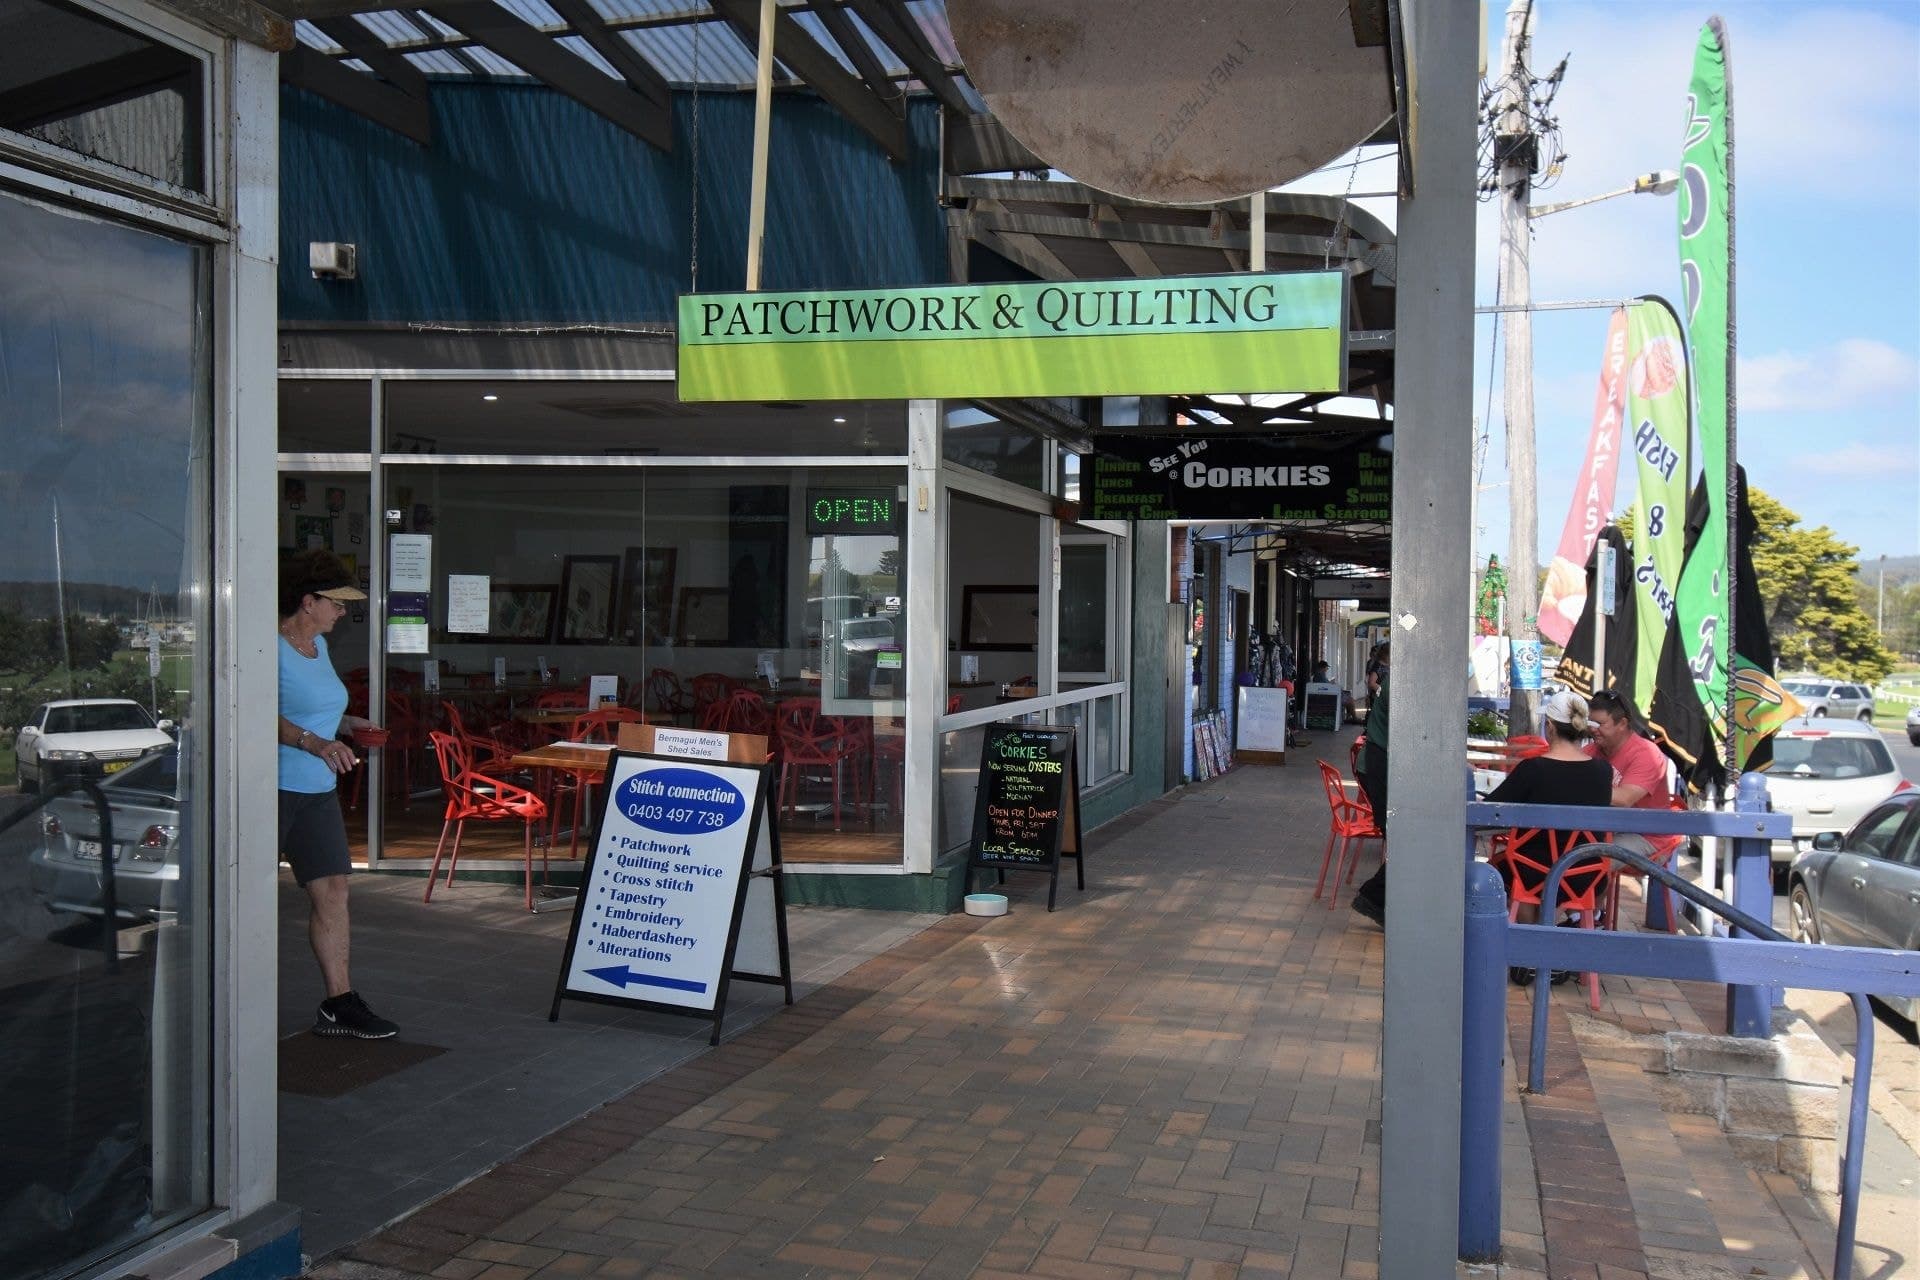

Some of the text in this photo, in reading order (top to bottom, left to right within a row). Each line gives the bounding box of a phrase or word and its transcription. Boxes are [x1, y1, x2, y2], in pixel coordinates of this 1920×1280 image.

[701, 285, 1278, 336] PATCHWORK & QUILTING
[1095, 457, 1141, 472] DINNER
[1148, 439, 1208, 473] SEE YOU
[1095, 473, 1133, 488] LUNCH
[1168, 461, 1331, 488] @ CORKIES
[1095, 489, 1164, 505] BREAKFAST
[1346, 488, 1389, 504] SPIRITS
[815, 499, 889, 522] OPEN
[1095, 505, 1121, 520] FISH
[1140, 505, 1178, 520] CHIPS
[1273, 503, 1388, 519] LOCAL SEAFOOD
[658, 733, 723, 746] Bermagui Men's
[667, 745, 713, 757] Shed Sales
[1000, 744, 1048, 760] CORKIES
[1028, 761, 1062, 774] OYSTERS
[629, 778, 736, 804] Stitch connection
[628, 803, 724, 827] 0403 497 738
[988, 805, 1009, 817] OPEN
[1028, 806, 1059, 820] DINNER
[620, 837, 692, 856] Patchwork
[983, 842, 1007, 854] LOCAL
[616, 854, 723, 878] Quilting service
[612, 871, 694, 893] Cross stitch
[609, 888, 668, 907] Tapestry
[605, 906, 684, 929] Embroidery
[600, 923, 698, 949] Haberdashery
[597, 941, 672, 963] Alterations
